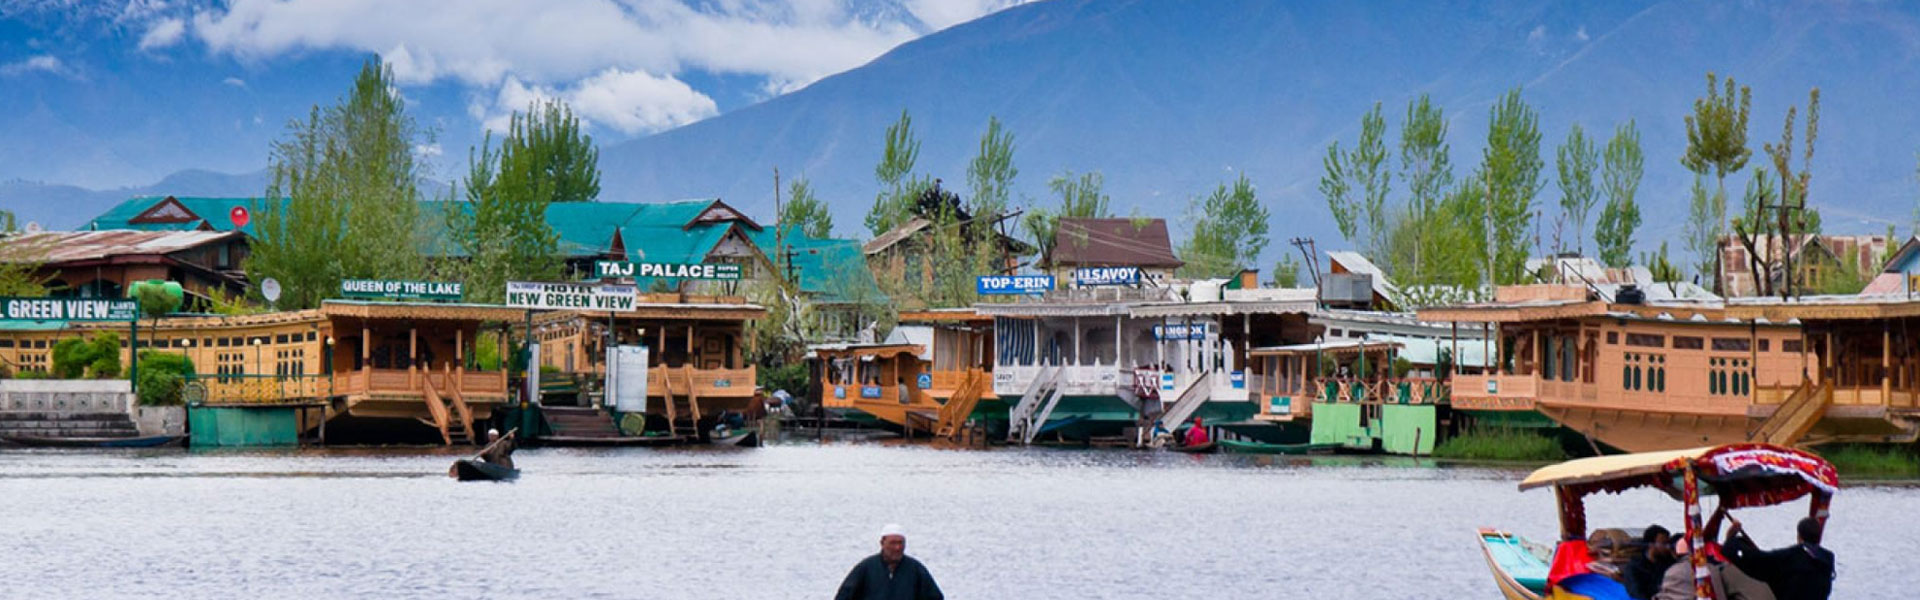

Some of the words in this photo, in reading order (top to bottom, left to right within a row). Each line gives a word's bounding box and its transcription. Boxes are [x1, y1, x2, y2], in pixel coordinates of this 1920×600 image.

[599, 262, 634, 275] TAJ
[641, 263, 715, 277] PALACE
[343, 280, 384, 292] QUEEN
[385, 282, 401, 292] OF
[403, 282, 426, 293] THE
[428, 283, 460, 295] LAKE
[544, 284, 595, 294] HOTEL
[981, 277, 1050, 289] TOP-ERIN
[509, 291, 540, 305] NEW
[546, 294, 590, 307] GREEN
[595, 295, 633, 309] VIEW
[8, 300, 62, 318] GREEN
[66, 300, 109, 318] VIEW
